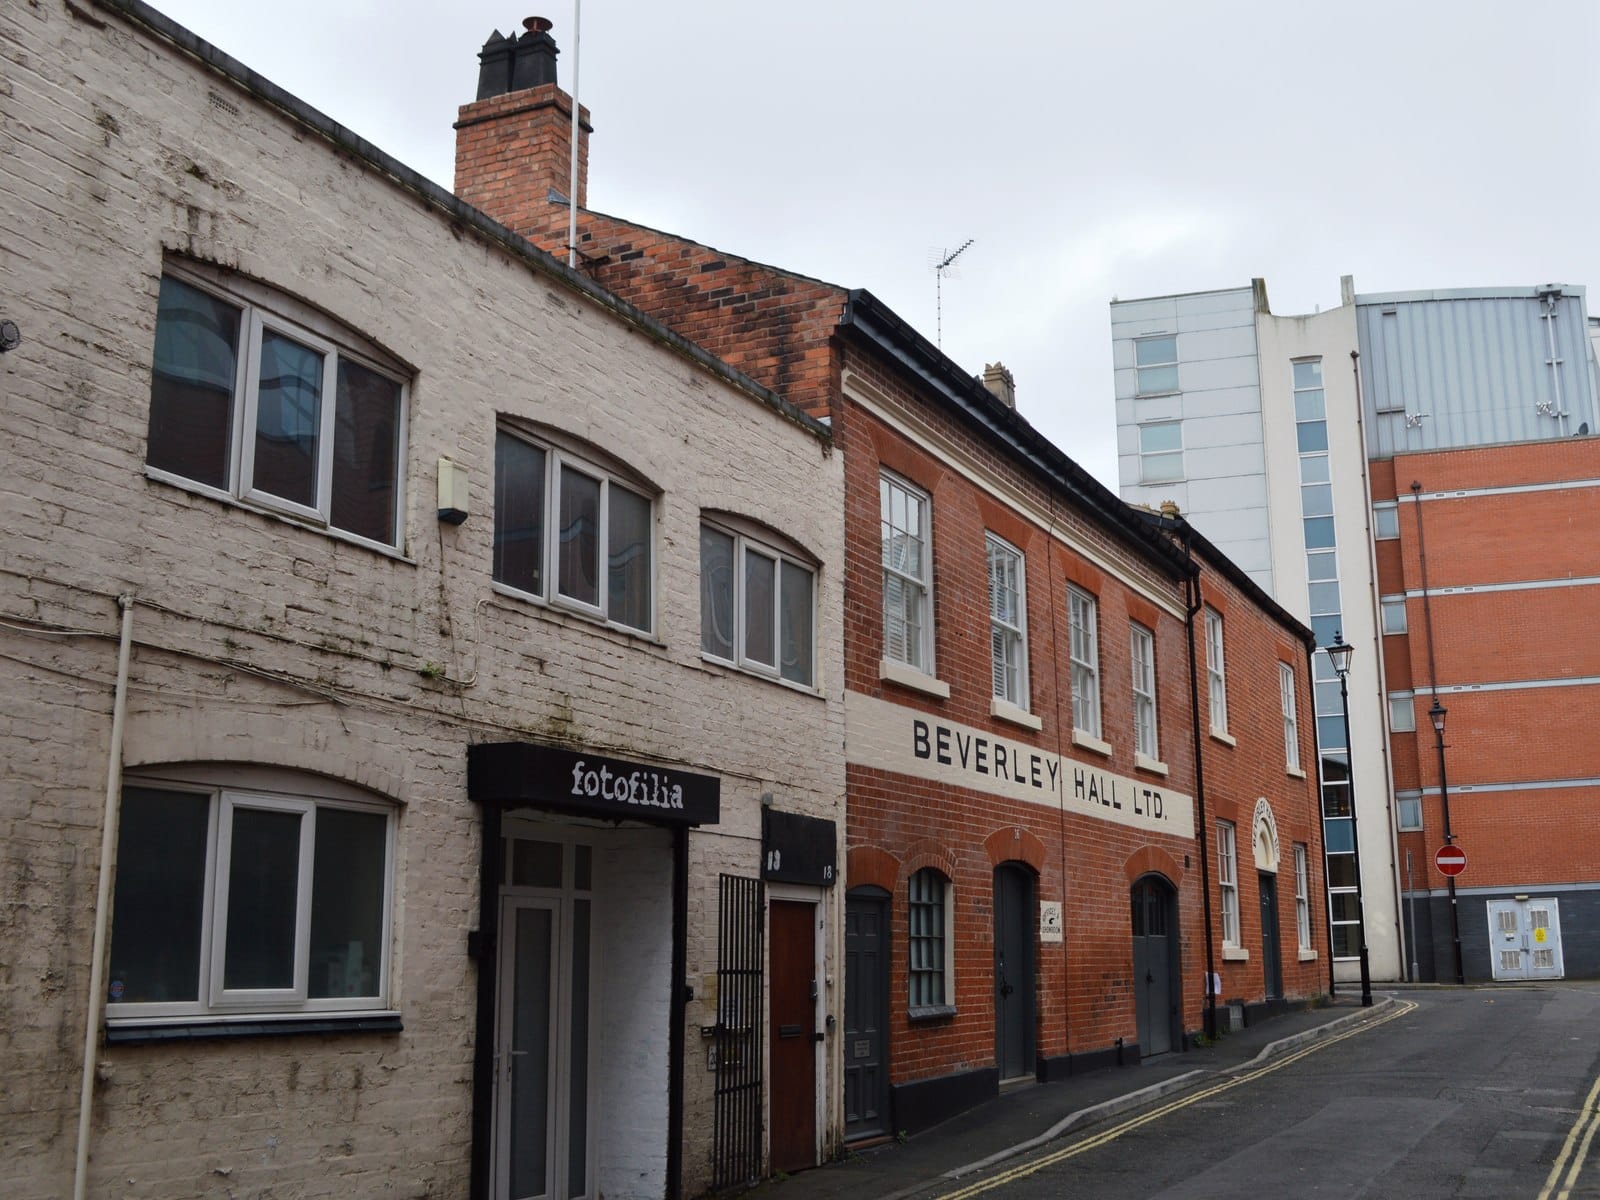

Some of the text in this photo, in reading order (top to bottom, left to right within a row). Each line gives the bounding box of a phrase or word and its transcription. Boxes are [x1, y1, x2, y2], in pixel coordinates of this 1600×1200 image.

[571, 761, 684, 809] fotofilia
[913, 719, 1168, 820] BEVERLEY HALL LTD.
[823, 865, 832, 879] 18
